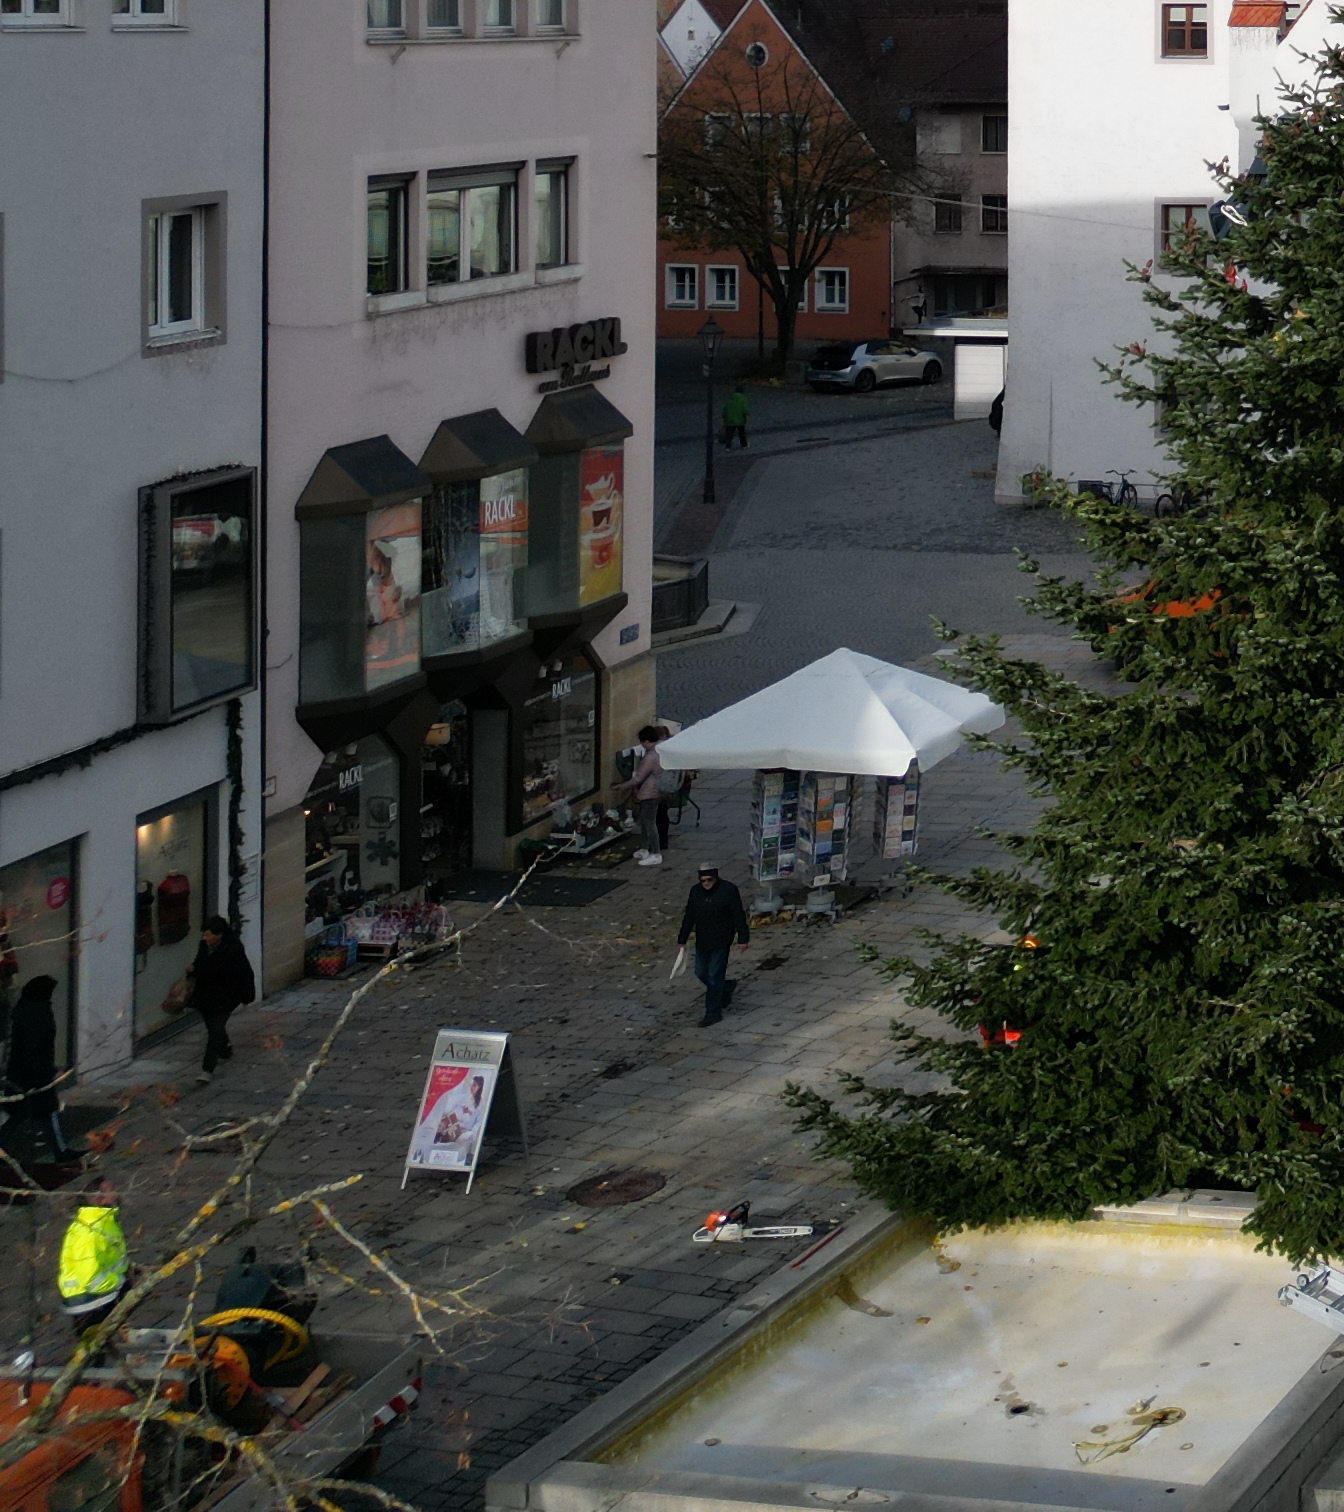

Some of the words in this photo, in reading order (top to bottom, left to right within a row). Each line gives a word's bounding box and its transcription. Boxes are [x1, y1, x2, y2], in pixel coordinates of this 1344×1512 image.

[526, 317, 628, 373] RACKL
[485, 494, 516, 528] RACKL
[552, 676, 572, 700] RACKL
[338, 764, 363, 790] RACKL
[441, 1041, 491, 1060] Achatz
